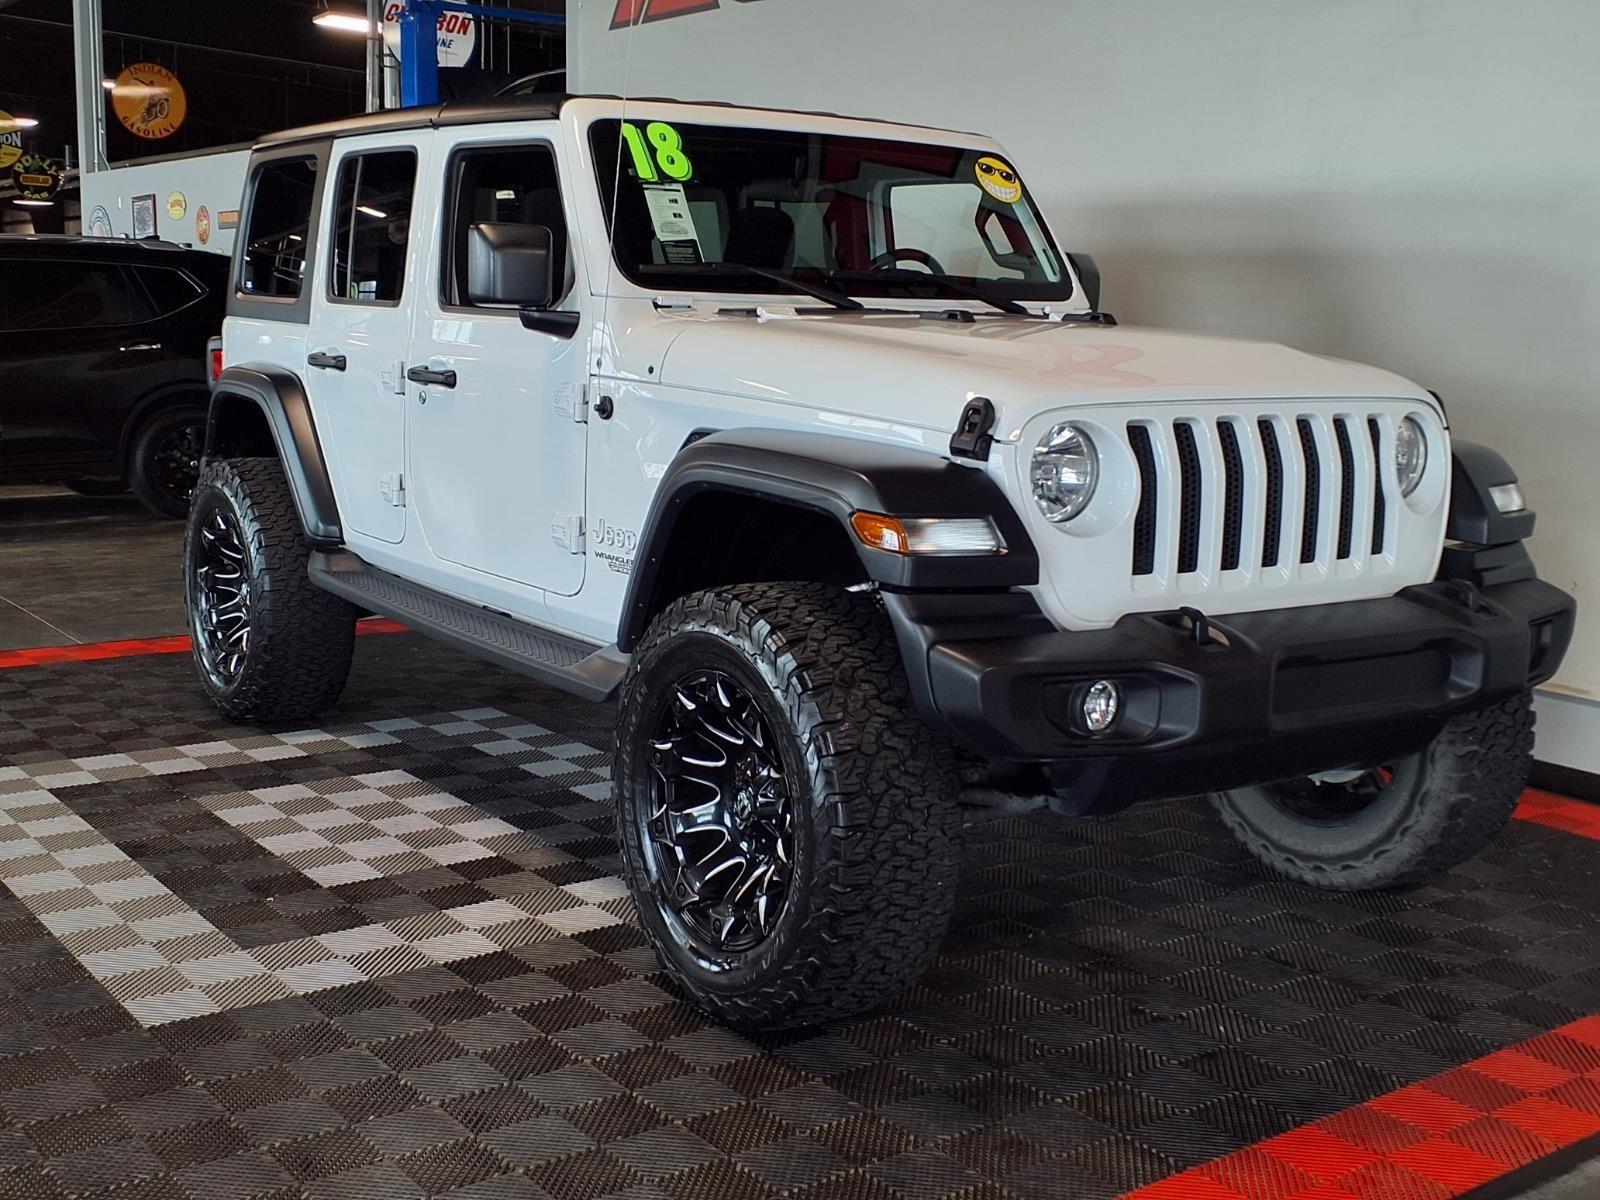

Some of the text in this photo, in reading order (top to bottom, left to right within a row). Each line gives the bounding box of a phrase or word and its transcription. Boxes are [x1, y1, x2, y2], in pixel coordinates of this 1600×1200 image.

[128, 64, 172, 82] INDIAN
[621, 122, 693, 181] 18
[24, 190, 49, 200] GAS
[592, 518, 637, 555] Jeep
